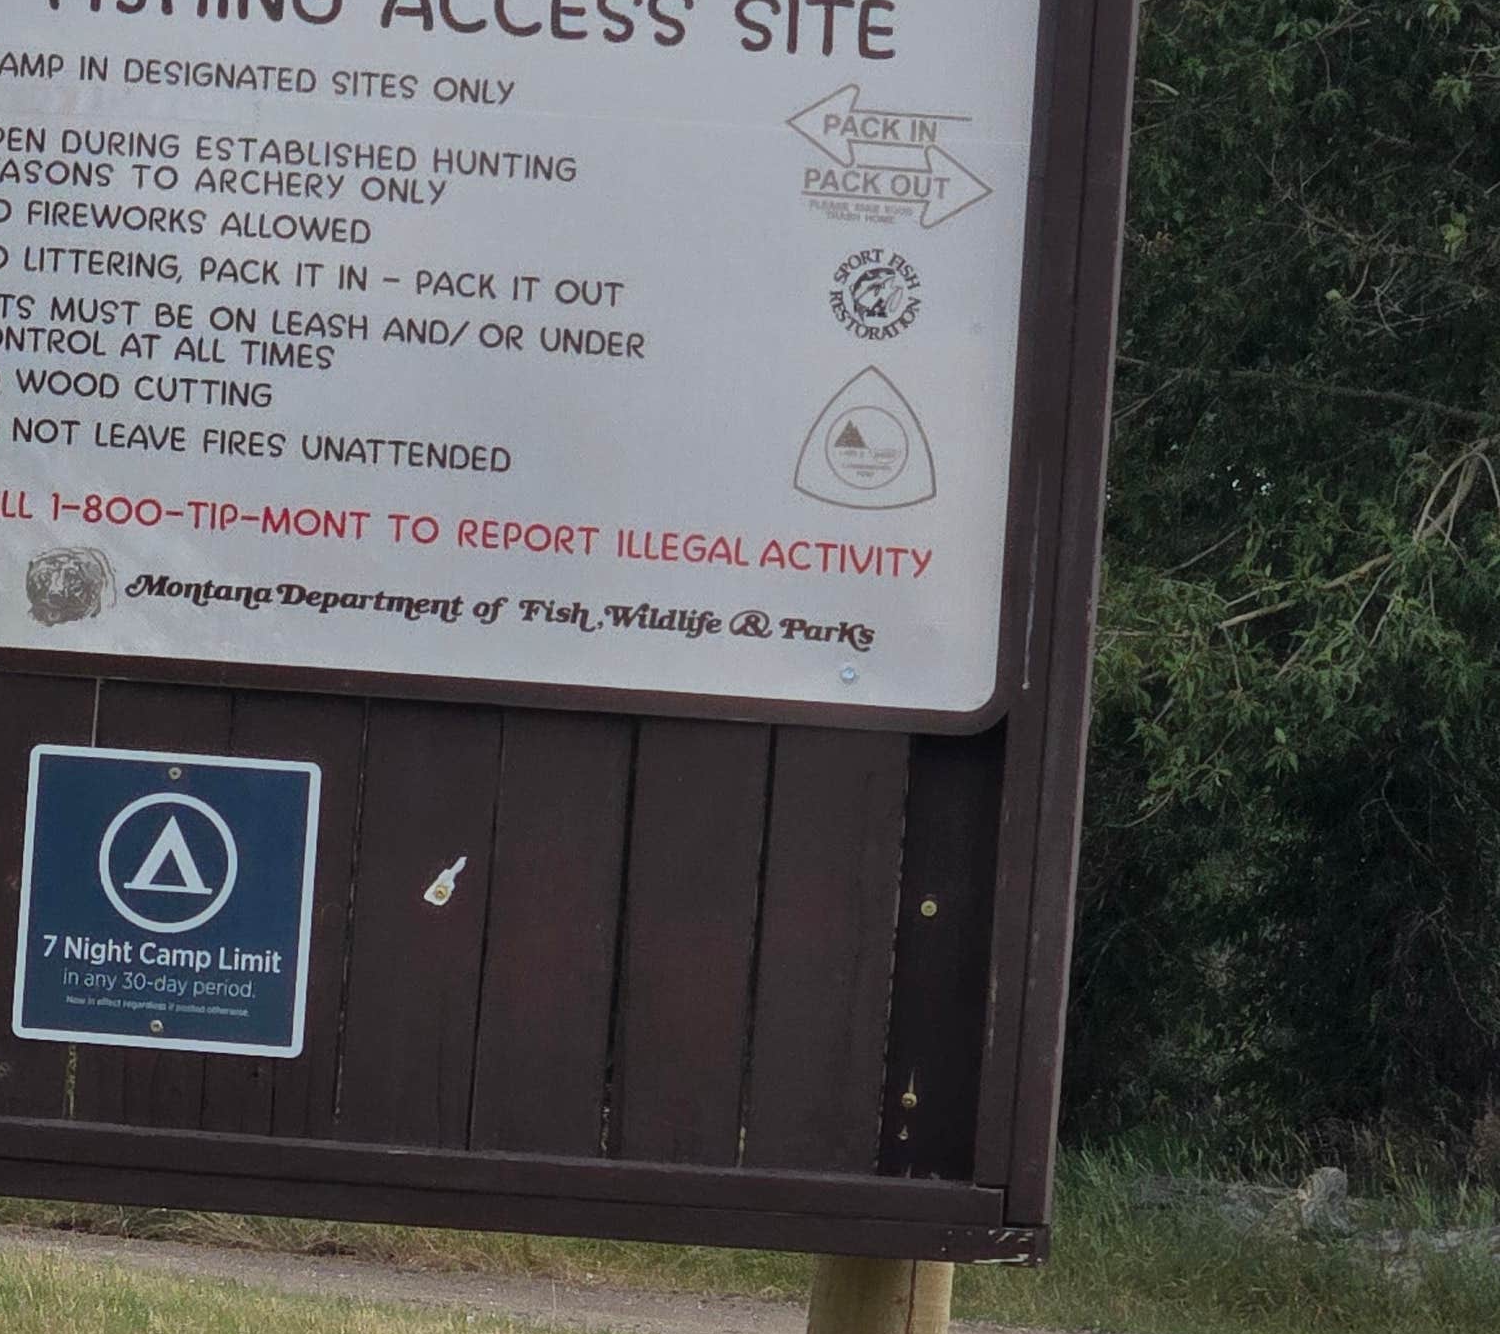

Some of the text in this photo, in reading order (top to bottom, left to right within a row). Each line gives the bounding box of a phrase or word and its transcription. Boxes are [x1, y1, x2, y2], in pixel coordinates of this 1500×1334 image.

[79, 56, 108, 82] IN
[124, 58, 317, 93] DESIGNATED
[332, 70, 419, 100] SITES
[433, 76, 515, 105] ONLY
[824, 114, 937, 142] PACK IN
[62, 129, 180, 159] DURING
[196, 135, 417, 172] ESTABLISHED
[433, 147, 577, 183] HUNTING
[132, 163, 178, 190] TO
[194, 167, 345, 199] ARCHERY
[361, 176, 446, 206] ONLY
[804, 168, 950, 199] PACK OUT
[27, 200, 207, 235] FIREWORKS
[220, 211, 371, 244] ALLOWED
[24, 245, 183, 284] LITTERING,
[200, 256, 280, 285] PACK
[295, 262, 324, 288] IT
[338, 264, 367, 292] IN
[416, 269, 496, 300] PACK
[513, 276, 540, 302] IT
[555, 279, 625, 308] OUT
[834, 248, 921, 290] SPORT FISH
[50, 296, 141, 326] MUST
[155, 302, 193, 329] BE
[210, 306, 256, 334] ON
[272, 310, 369, 341] LEASH
[540, 326, 645, 359] UNDER
[829, 290, 921, 341] RESTORATION
[120, 333, 162, 359] AT
[174, 336, 226, 364] ALL
[240, 340, 335, 370] TIMES
[16, 369, 119, 399] WOOD
[135, 375, 273, 408] CUTTING
[12, 416, 81, 446] NOT
[95, 422, 186, 452] LEAVE
[203, 429, 287, 458] FIRES
[301, 434, 511, 473] UNATTENDED
[50, 492, 370, 540] 1-800-TIP-MONT
[388, 514, 439, 544] TO
[458, 518, 600, 556] REPORT
[617, 529, 749, 566] ILLEGAL
[759, 539, 933, 579] ACTIVITY
[125, 573, 273, 610] Montana
[276, 582, 464, 624] Department
[472, 595, 508, 625] of
[728, 609, 773, 638] &
[43, 934, 282, 974] 7 Night Camp Limit
[63, 968, 255, 999] in any 30-day period.
